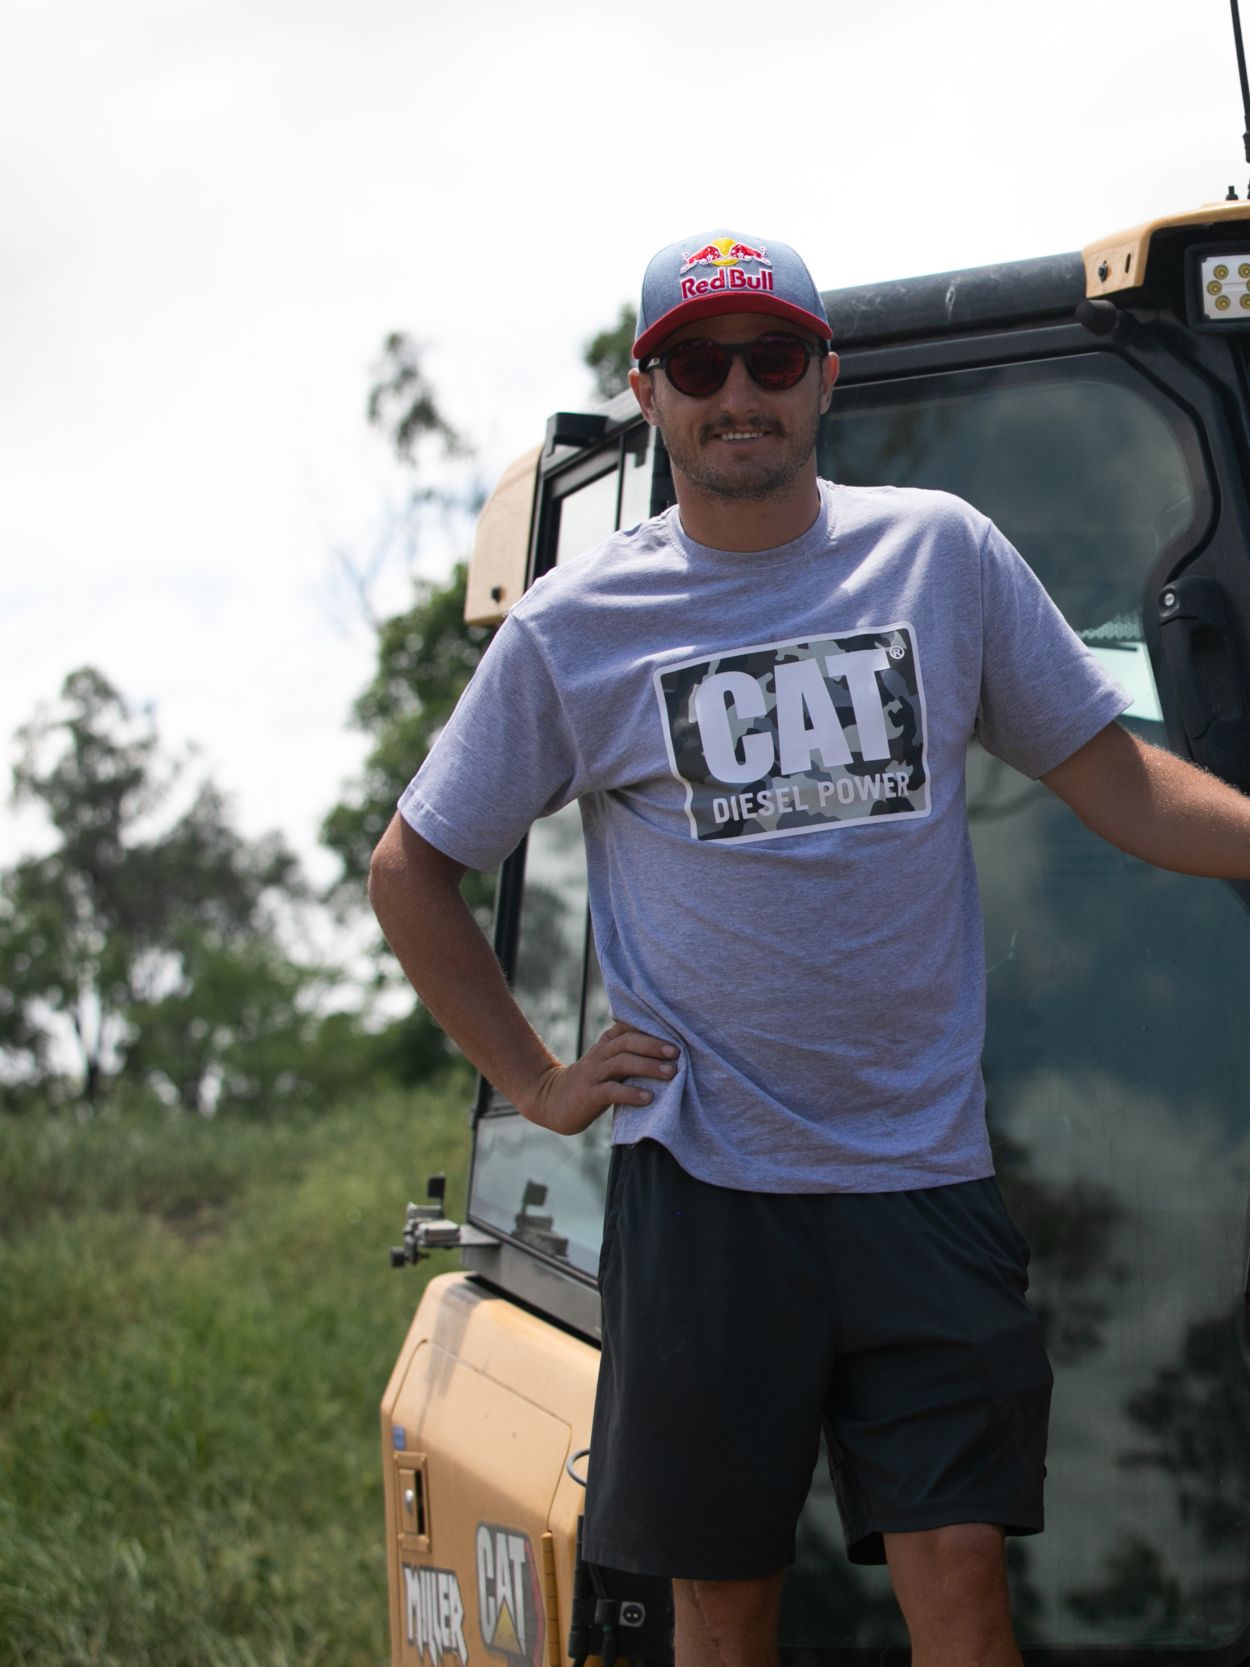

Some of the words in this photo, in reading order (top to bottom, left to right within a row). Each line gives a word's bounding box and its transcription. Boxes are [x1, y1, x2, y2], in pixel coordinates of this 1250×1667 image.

[680, 268, 726, 300] Red
[728, 267, 774, 292] Bull
[712, 785, 809, 824] DIESEL
[817, 771, 911, 808] POWER
[476, 1525, 527, 1657] CAT
